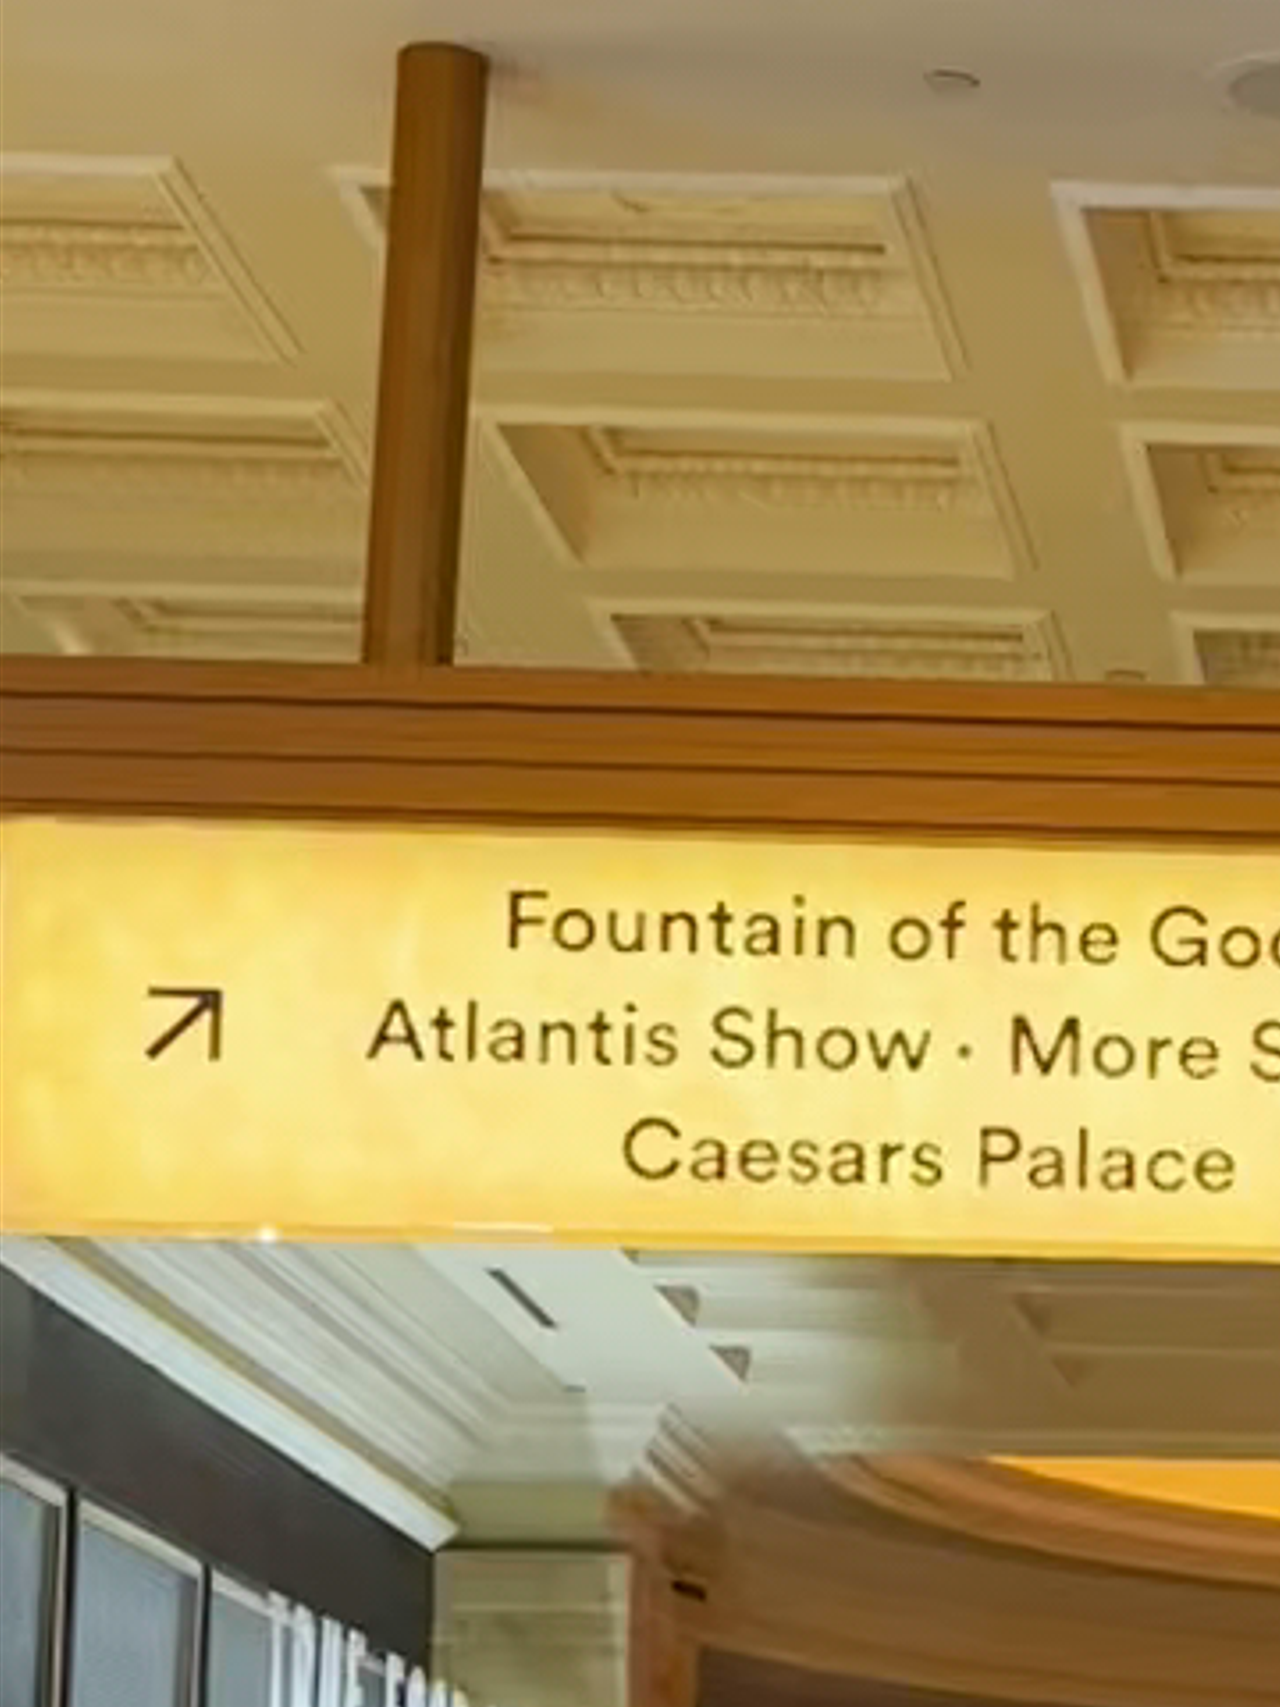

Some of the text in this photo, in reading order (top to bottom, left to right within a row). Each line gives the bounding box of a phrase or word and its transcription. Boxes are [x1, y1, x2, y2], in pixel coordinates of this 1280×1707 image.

[507, 889, 856, 958] Fountain
[888, 899, 968, 961] of
[992, 907, 1120, 966] the
[366, 998, 678, 1068] Atlantis
[709, 1005, 931, 1072] Show
[1010, 1014, 1220, 1079] More
[622, 1116, 1235, 1192] Caesars Palace
